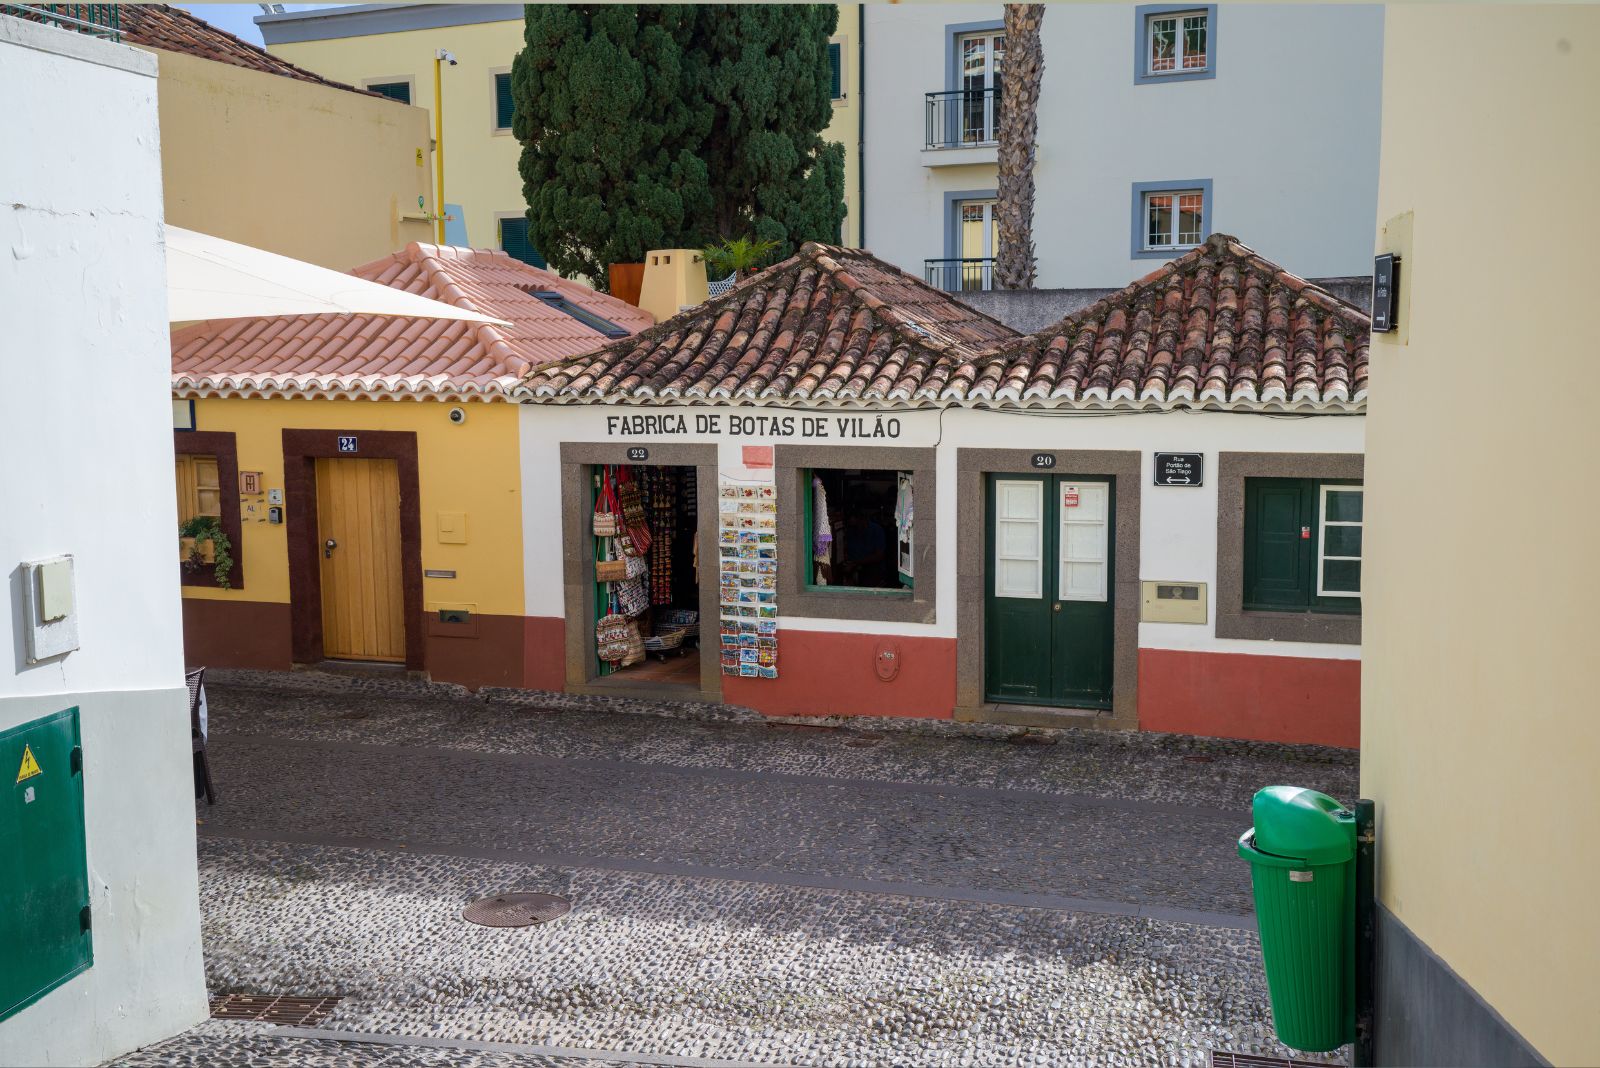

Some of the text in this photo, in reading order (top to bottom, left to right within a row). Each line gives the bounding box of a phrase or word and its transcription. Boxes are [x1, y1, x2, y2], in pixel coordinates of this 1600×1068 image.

[607, 414, 900, 438] FABRICA DE BOTAS DE VILÃO
[341, 438, 354, 451] 24
[631, 449, 645, 458] 22
[1036, 456, 1052, 466] 20
